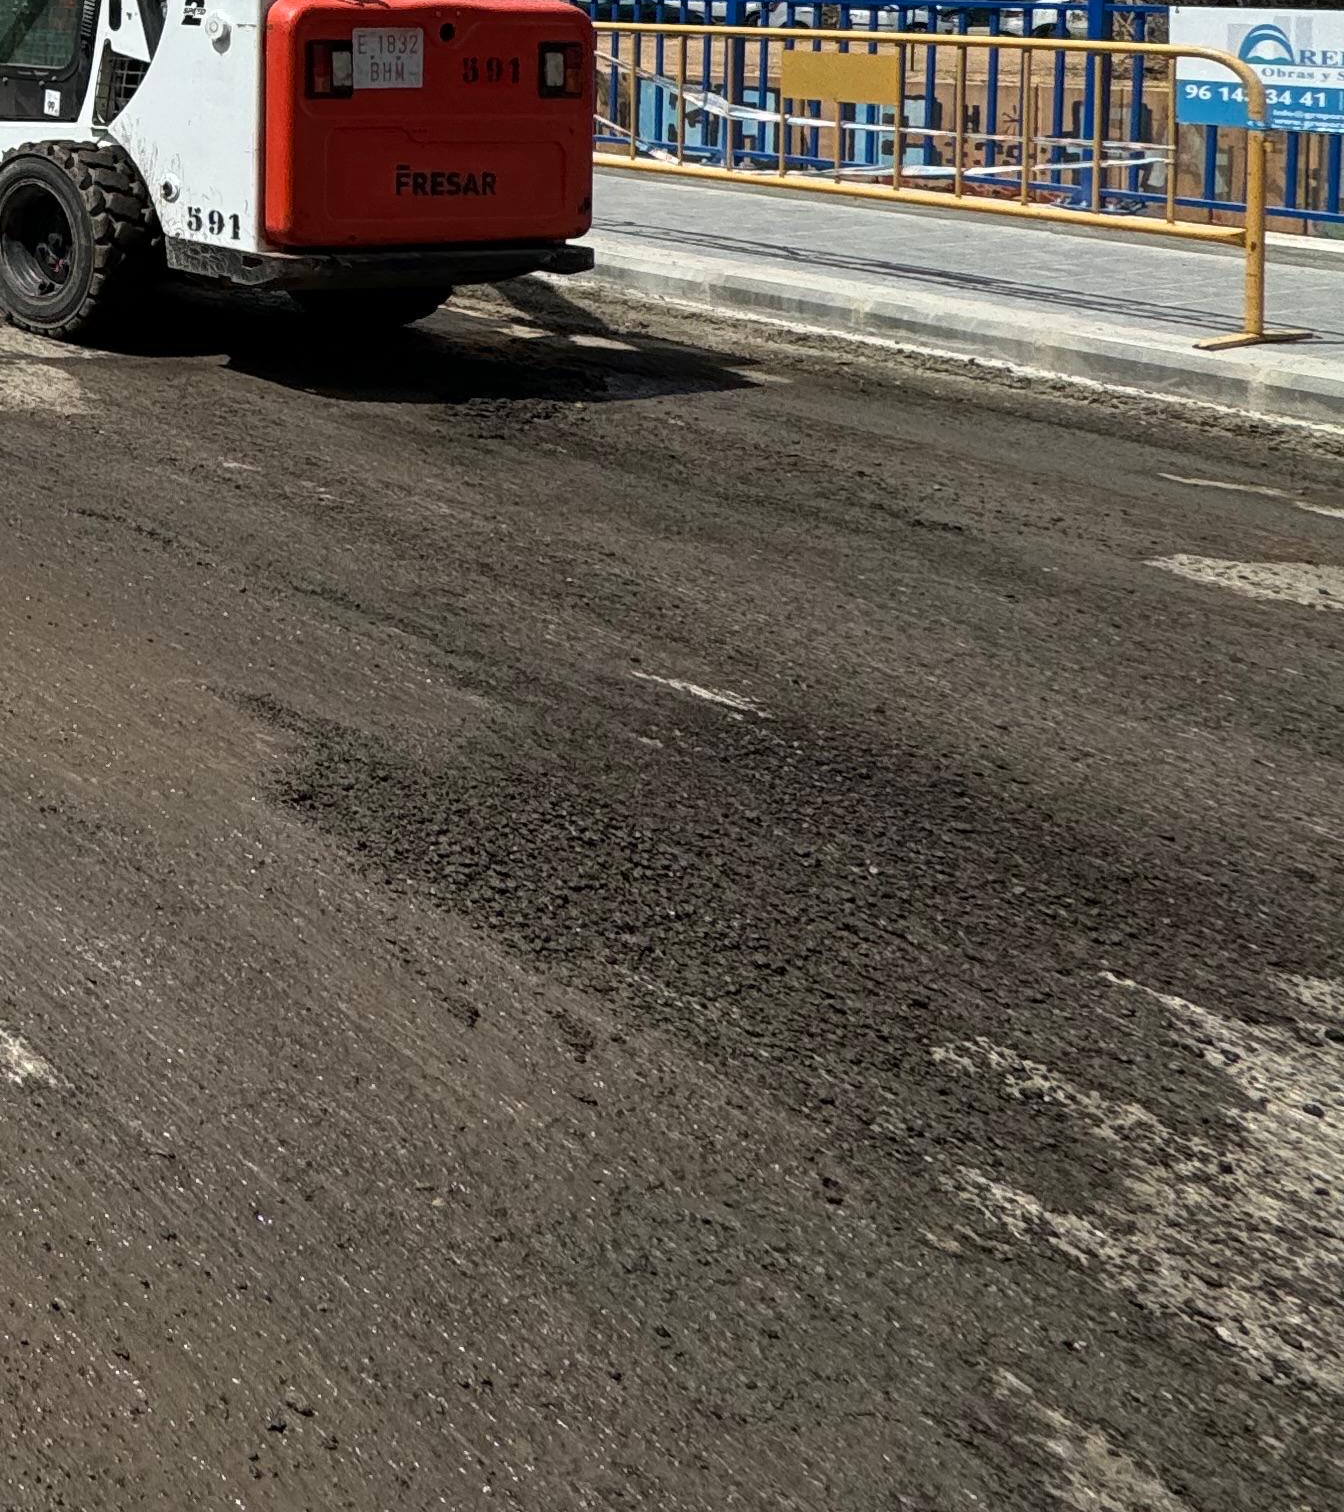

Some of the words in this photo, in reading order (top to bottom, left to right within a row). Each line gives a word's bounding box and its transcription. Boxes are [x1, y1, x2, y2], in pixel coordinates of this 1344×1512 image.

[357, 34, 368, 55] E
[377, 34, 418, 55] 1832
[1298, 48, 1344, 67] RE
[370, 61, 405, 82] BHM
[462, 56, 521, 85] 591
[1261, 67, 1315, 80] Obras
[1184, 84, 1212, 101] 96
[1218, 86, 1248, 103] 14
[1265, 89, 1292, 106] 34
[1299, 91, 1327, 108] 41
[395, 169, 497, 196] FRESAR
[187, 206, 241, 240] 591
